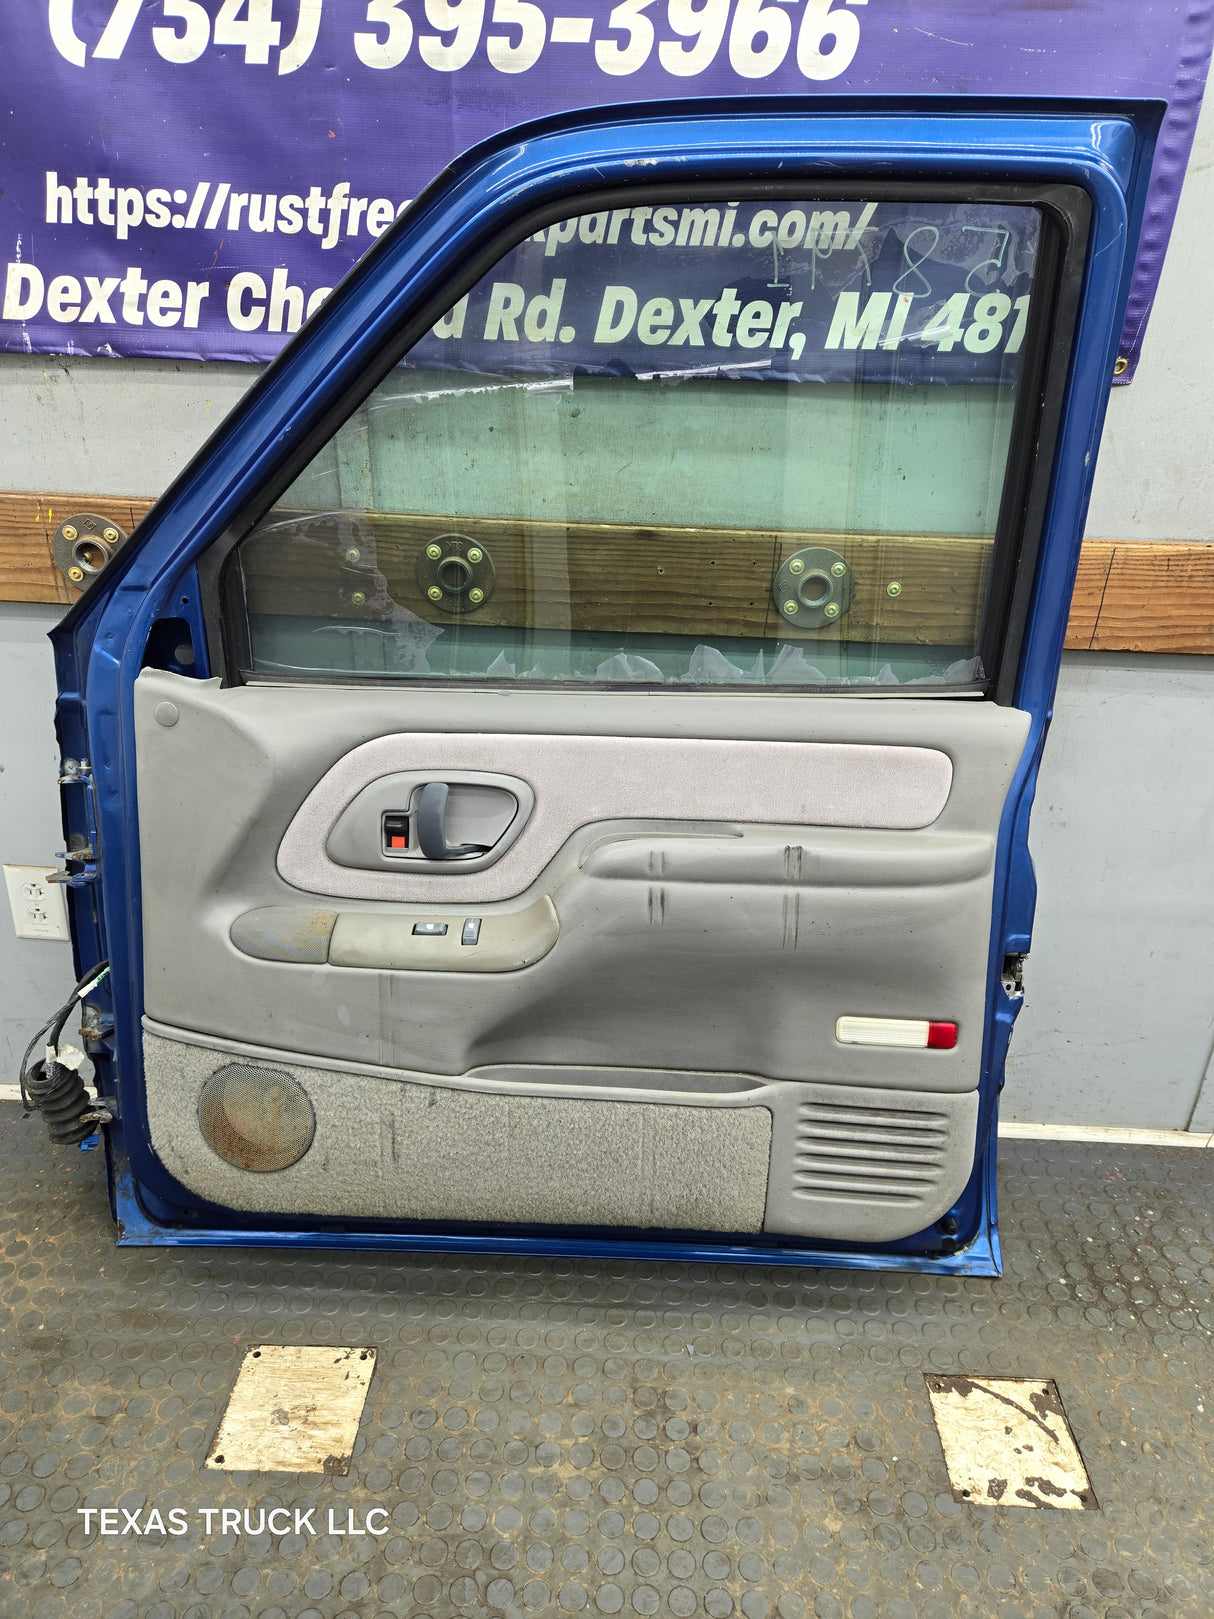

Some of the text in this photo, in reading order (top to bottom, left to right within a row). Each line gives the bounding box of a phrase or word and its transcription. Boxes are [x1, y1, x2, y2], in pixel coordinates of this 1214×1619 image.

[353, 0, 868, 81] 395-3966
[2, 262, 210, 328] Dexter
[483, 278, 576, 343] Rd.
[593, 285, 807, 361] Dexter,
[824, 291, 914, 351] MI
